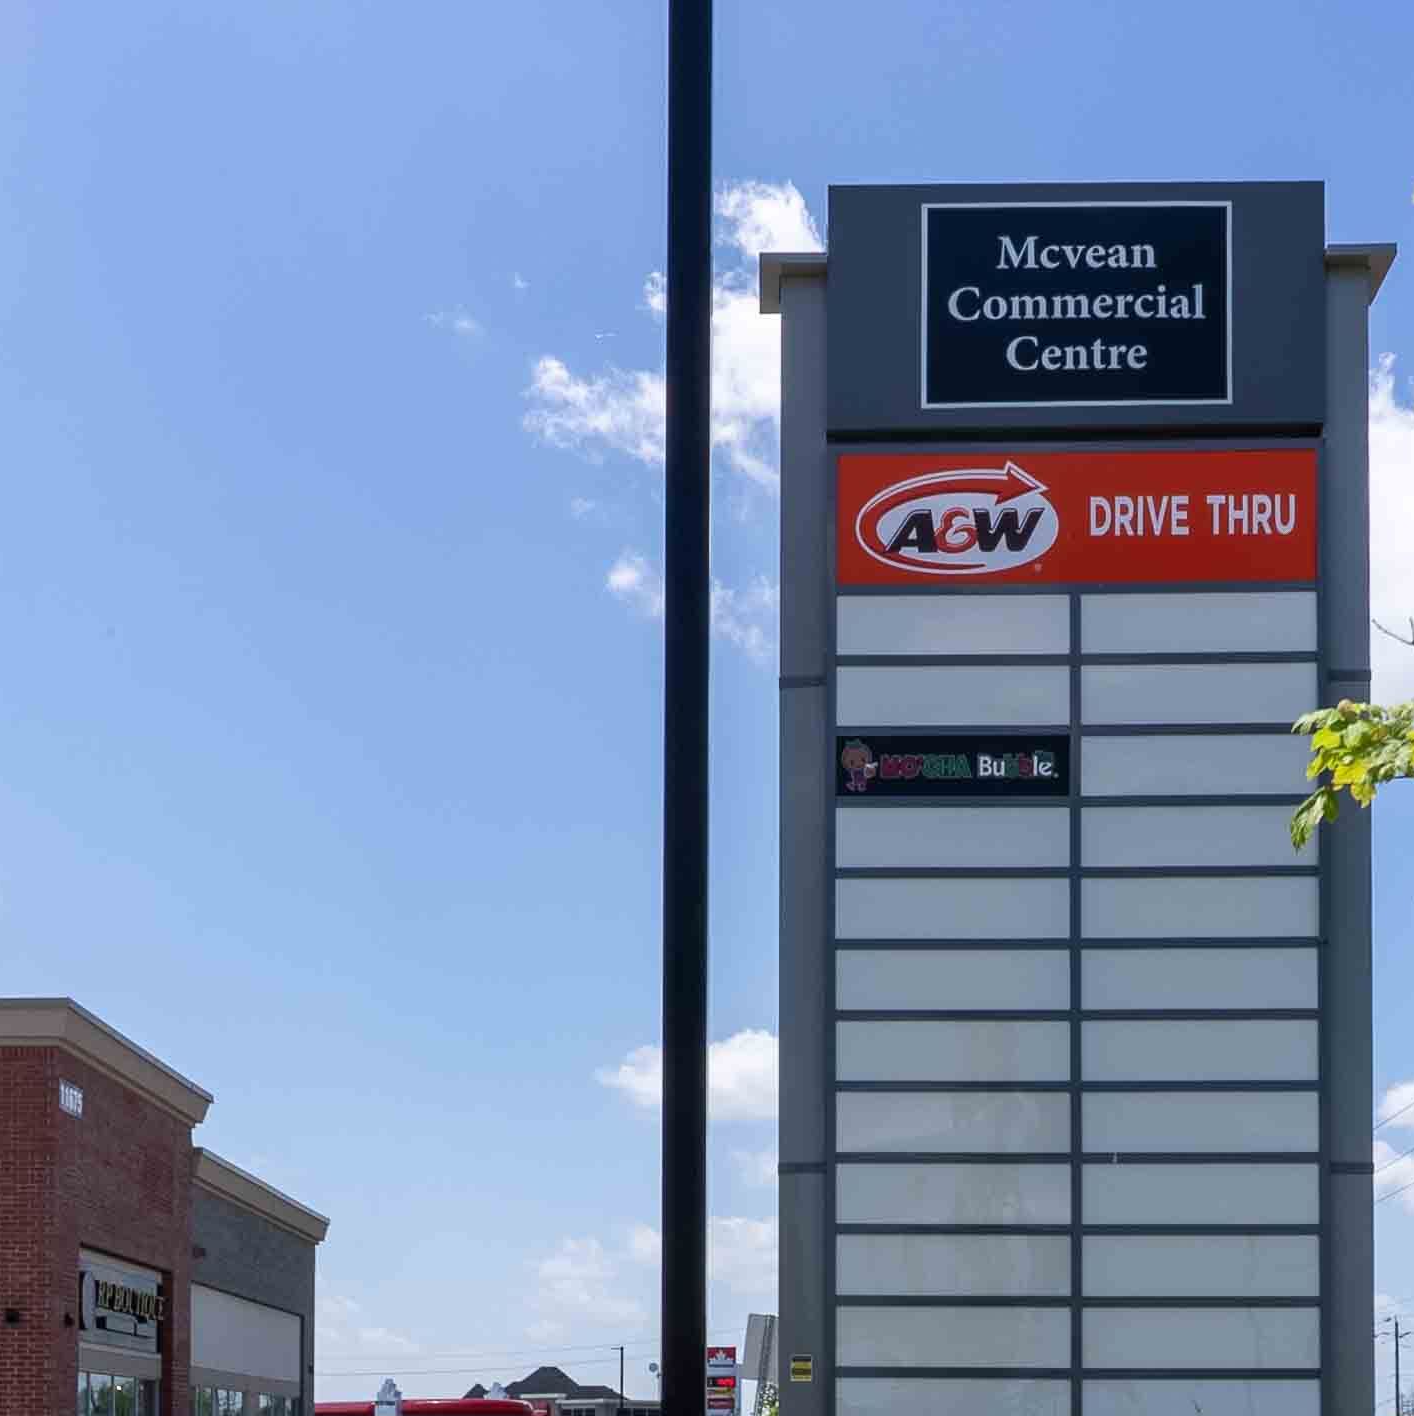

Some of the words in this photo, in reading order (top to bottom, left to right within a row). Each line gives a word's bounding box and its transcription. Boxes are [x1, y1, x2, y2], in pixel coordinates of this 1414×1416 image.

[996, 236, 1157, 269] Mcvean
[947, 284, 1207, 321] Commercial
[1006, 336, 1148, 371] Centre
[883, 507, 1044, 553] A&W
[1090, 496, 1190, 537] DRIVE
[1206, 494, 1297, 535] THRU
